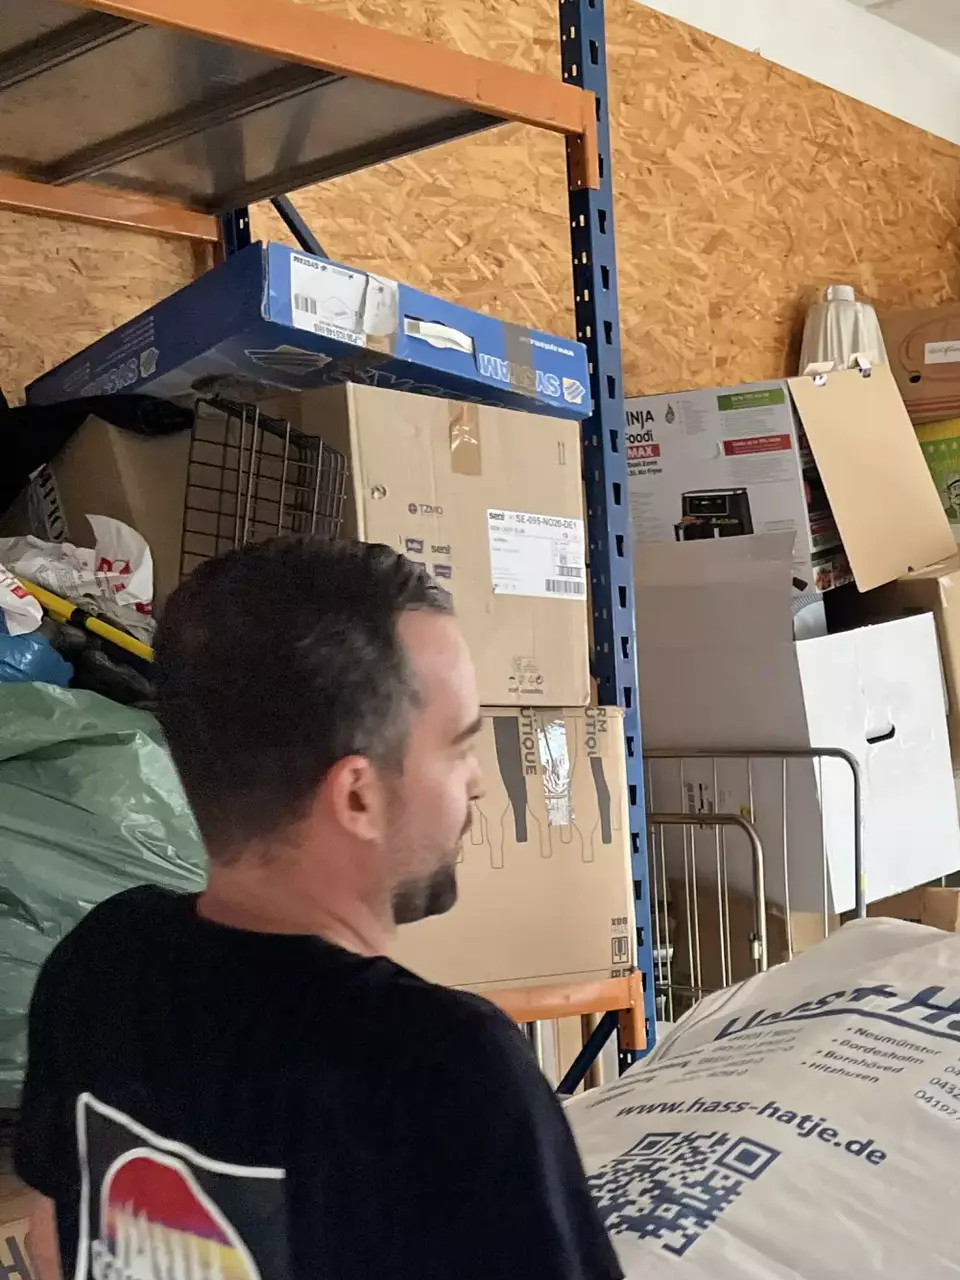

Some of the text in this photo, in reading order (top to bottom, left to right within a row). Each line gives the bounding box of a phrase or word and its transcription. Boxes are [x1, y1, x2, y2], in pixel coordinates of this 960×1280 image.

[626, 410, 654, 430] INJA
[627, 446, 654, 459] MAX
[419, 504, 443, 515] TZMO
[489, 512, 505, 521] seni
[431, 544, 452, 555] seni
[521, 707, 537, 776] UTIQUE
[839, 1039, 925, 1066] Bordesholm
[854, 1027, 942, 1057] Neumünster
[808, 1061, 880, 1085] Hitzhusen
[823, 1051, 904, 1075] Bornhöved
[615, 1097, 888, 1166] www.hass-hatje.de
